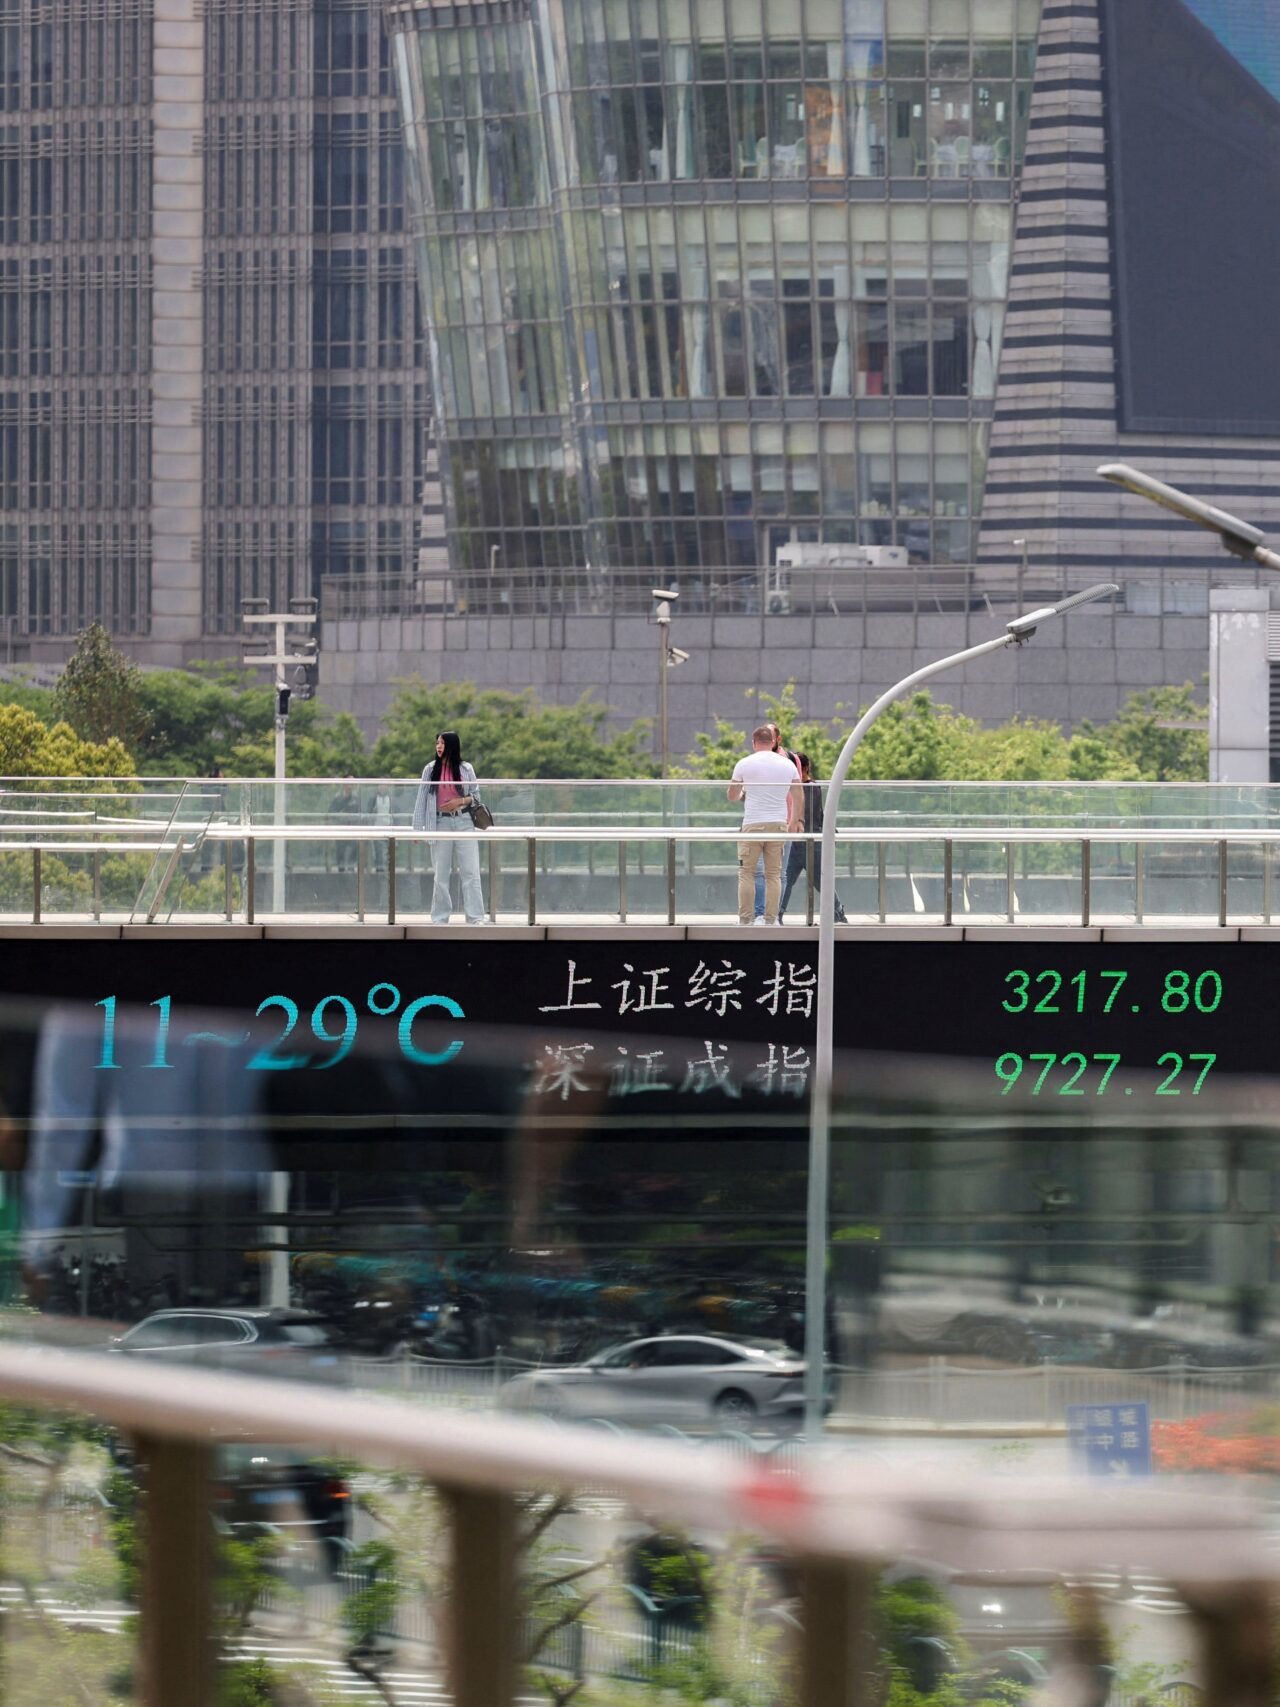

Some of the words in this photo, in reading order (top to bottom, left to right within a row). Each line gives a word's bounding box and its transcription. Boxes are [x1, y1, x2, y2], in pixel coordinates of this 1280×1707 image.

[538, 959, 818, 1018] 上证综指
[1002, 970, 1223, 1013] 3217.80
[534, 1040, 811, 1100] 深证成指
[994, 1052, 1217, 1095] 9727.27
